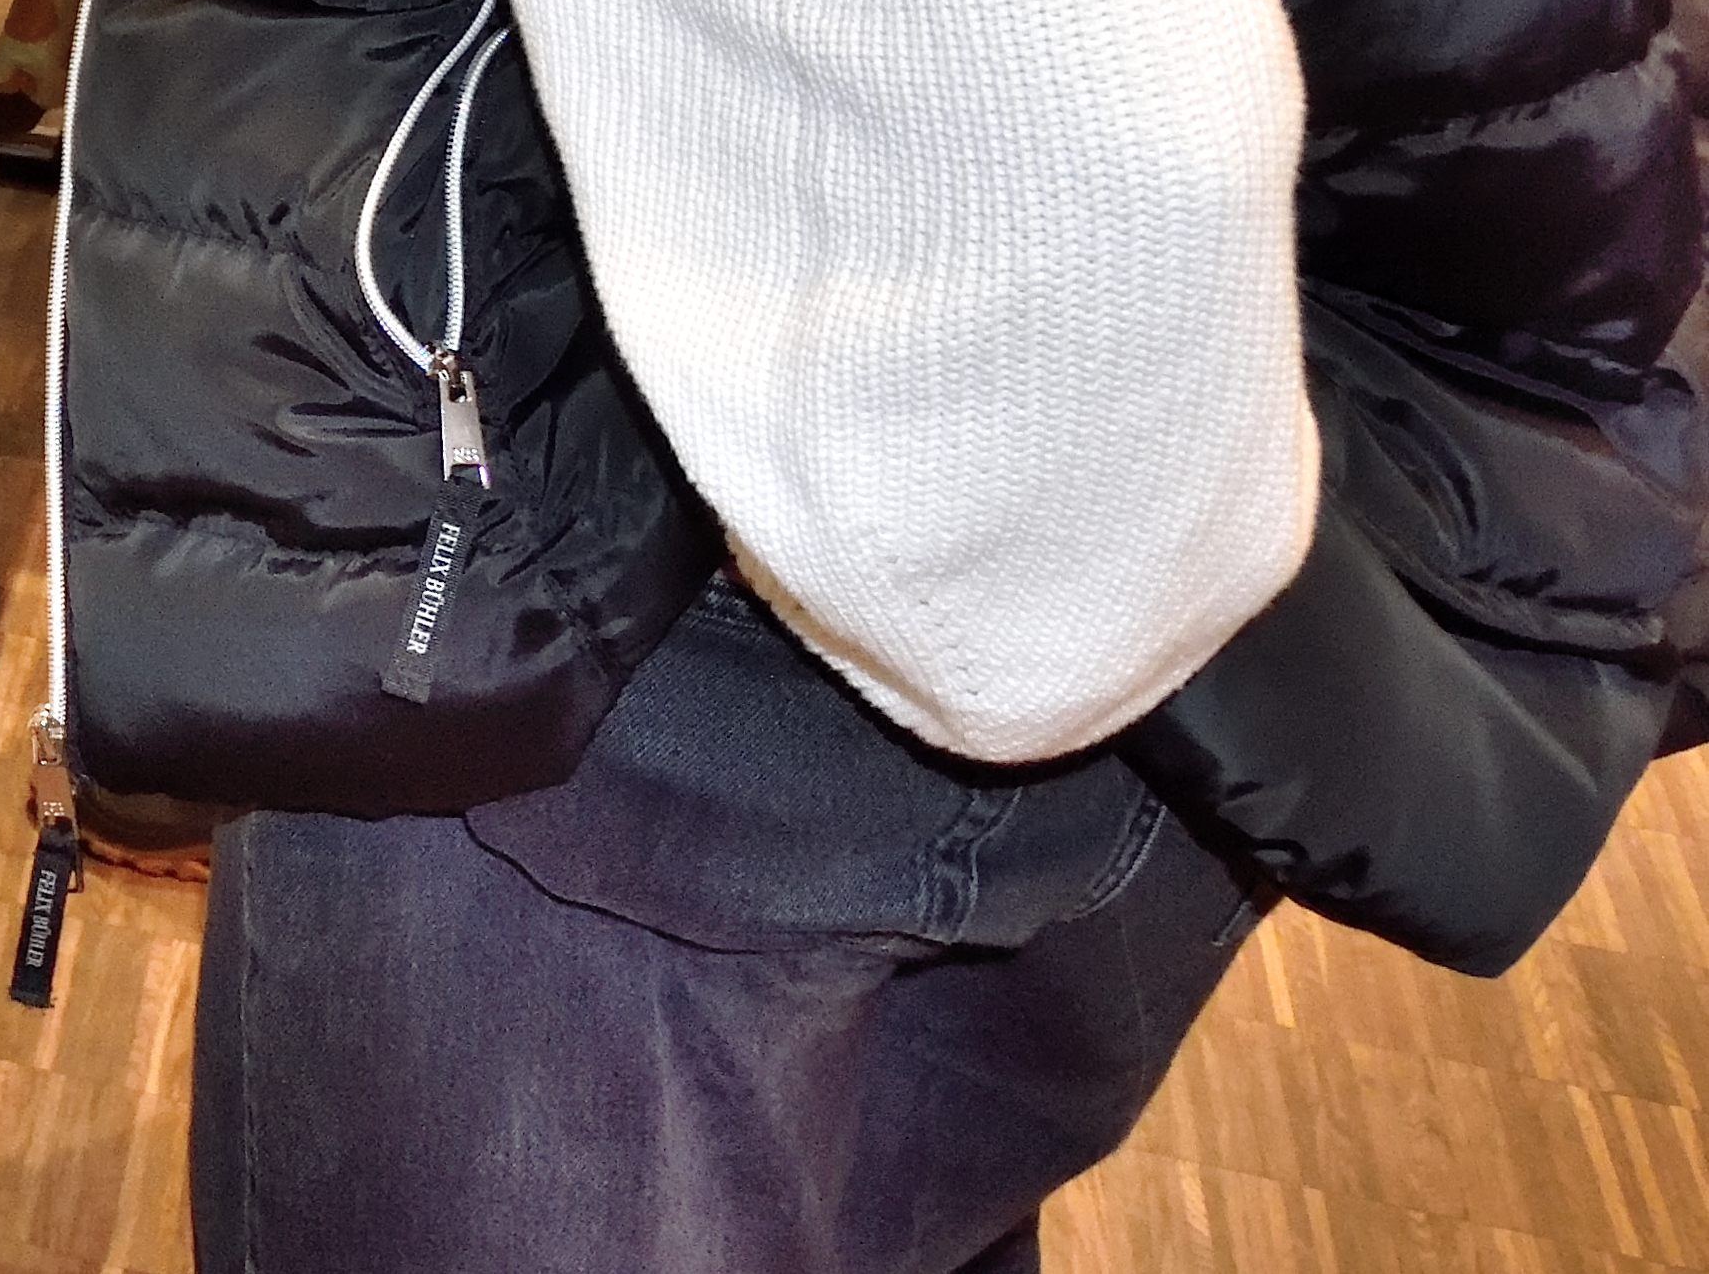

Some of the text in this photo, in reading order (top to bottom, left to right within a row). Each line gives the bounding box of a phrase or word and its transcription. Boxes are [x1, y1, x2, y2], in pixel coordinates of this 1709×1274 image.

[405, 521, 462, 656] FELIX BÜHLER
[35, 868, 57, 919] FELIX
